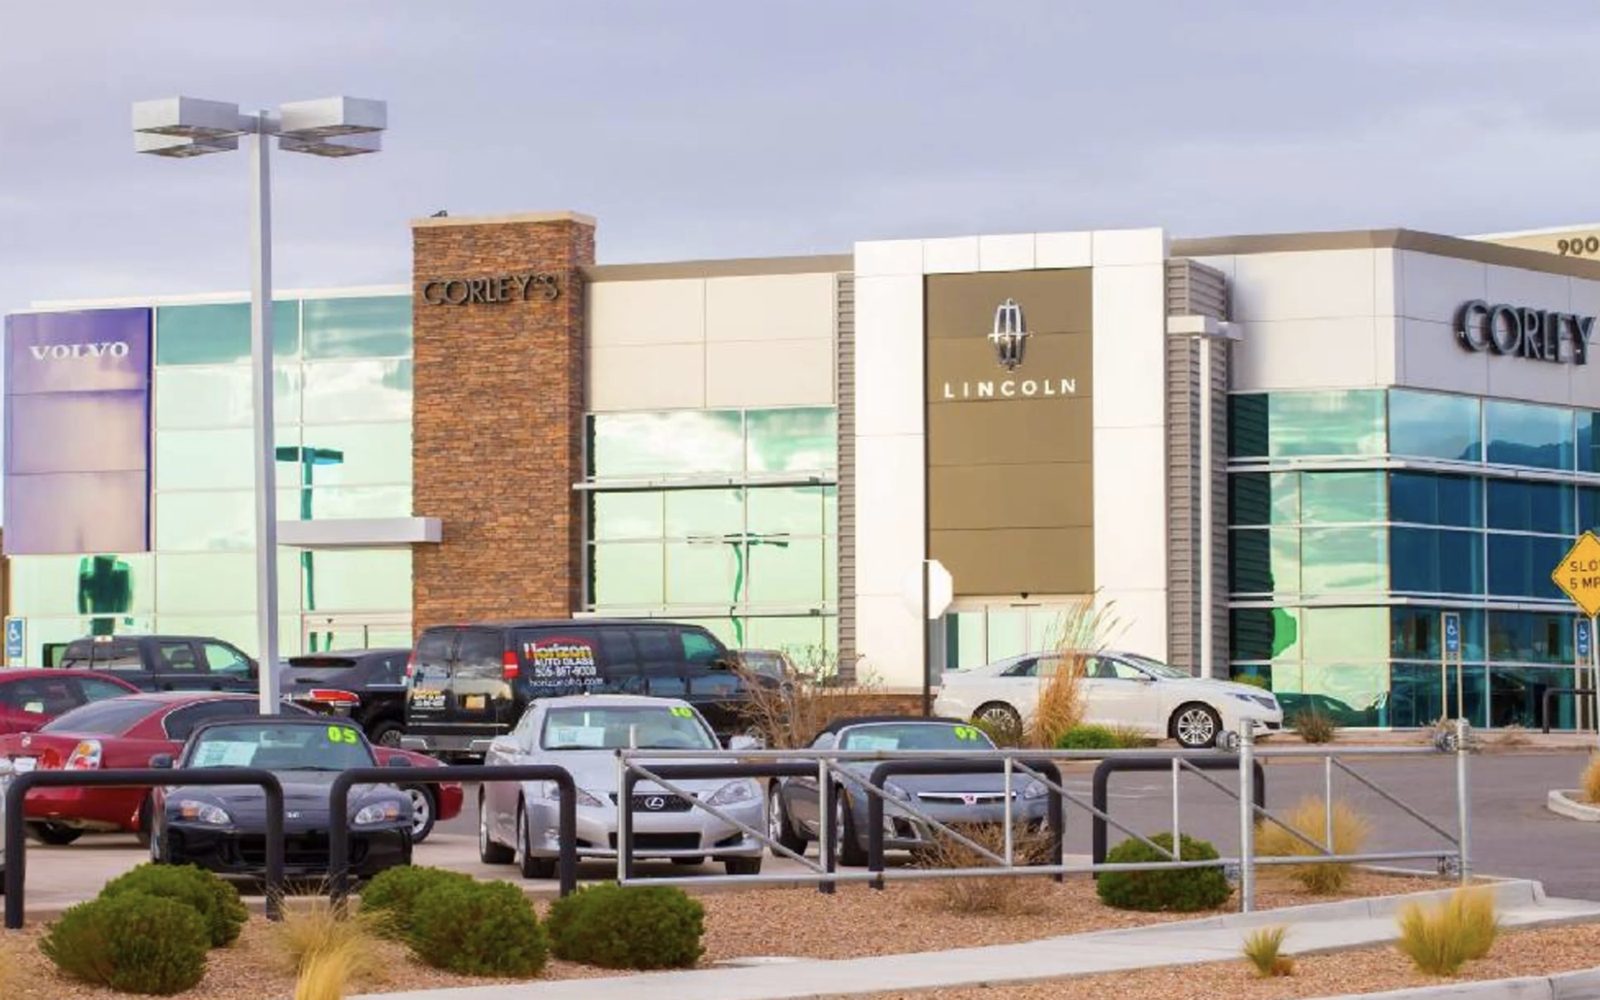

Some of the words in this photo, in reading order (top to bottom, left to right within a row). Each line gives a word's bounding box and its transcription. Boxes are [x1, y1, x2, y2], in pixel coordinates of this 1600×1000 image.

[1557, 236, 1599, 256] 900
[423, 272, 560, 305] CORLEY'S
[1454, 299, 1597, 365] CORLEY
[29, 341, 129, 360] VOLVO
[944, 378, 1076, 398] LINCOLN
[1570, 559, 1600, 572] SLO
[1570, 577, 1578, 590] 5
[523, 642, 592, 659] Horizon
[534, 658, 560, 667] AUTO
[562, 658, 595, 666] GLASS
[327, 726, 357, 744] 05
